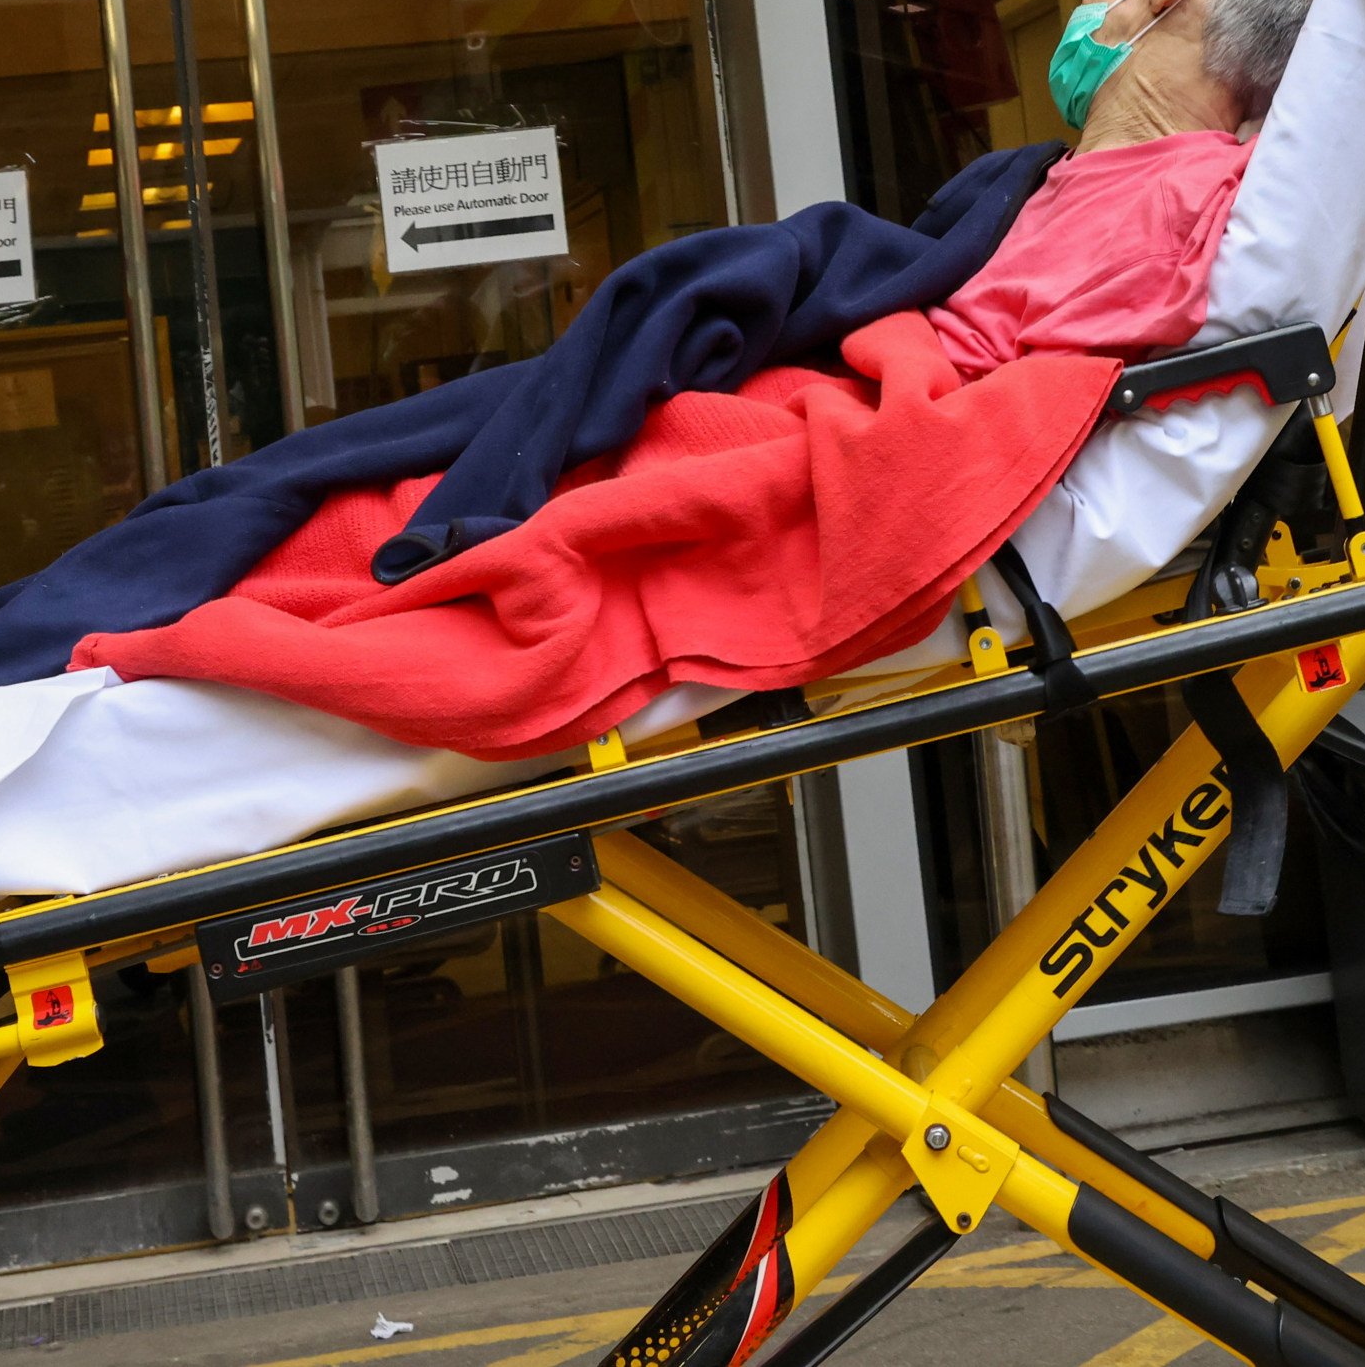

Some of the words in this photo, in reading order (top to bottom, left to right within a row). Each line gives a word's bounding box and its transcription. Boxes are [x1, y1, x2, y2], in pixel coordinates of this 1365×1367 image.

[390, 154, 548, 195] 請使用自動門
[394, 204, 432, 217] Please
[434, 200, 454, 213] use
[457, 196, 517, 209] Automatic
[520, 192, 549, 204] Door
[248, 860, 521, 948] MX-PRO
